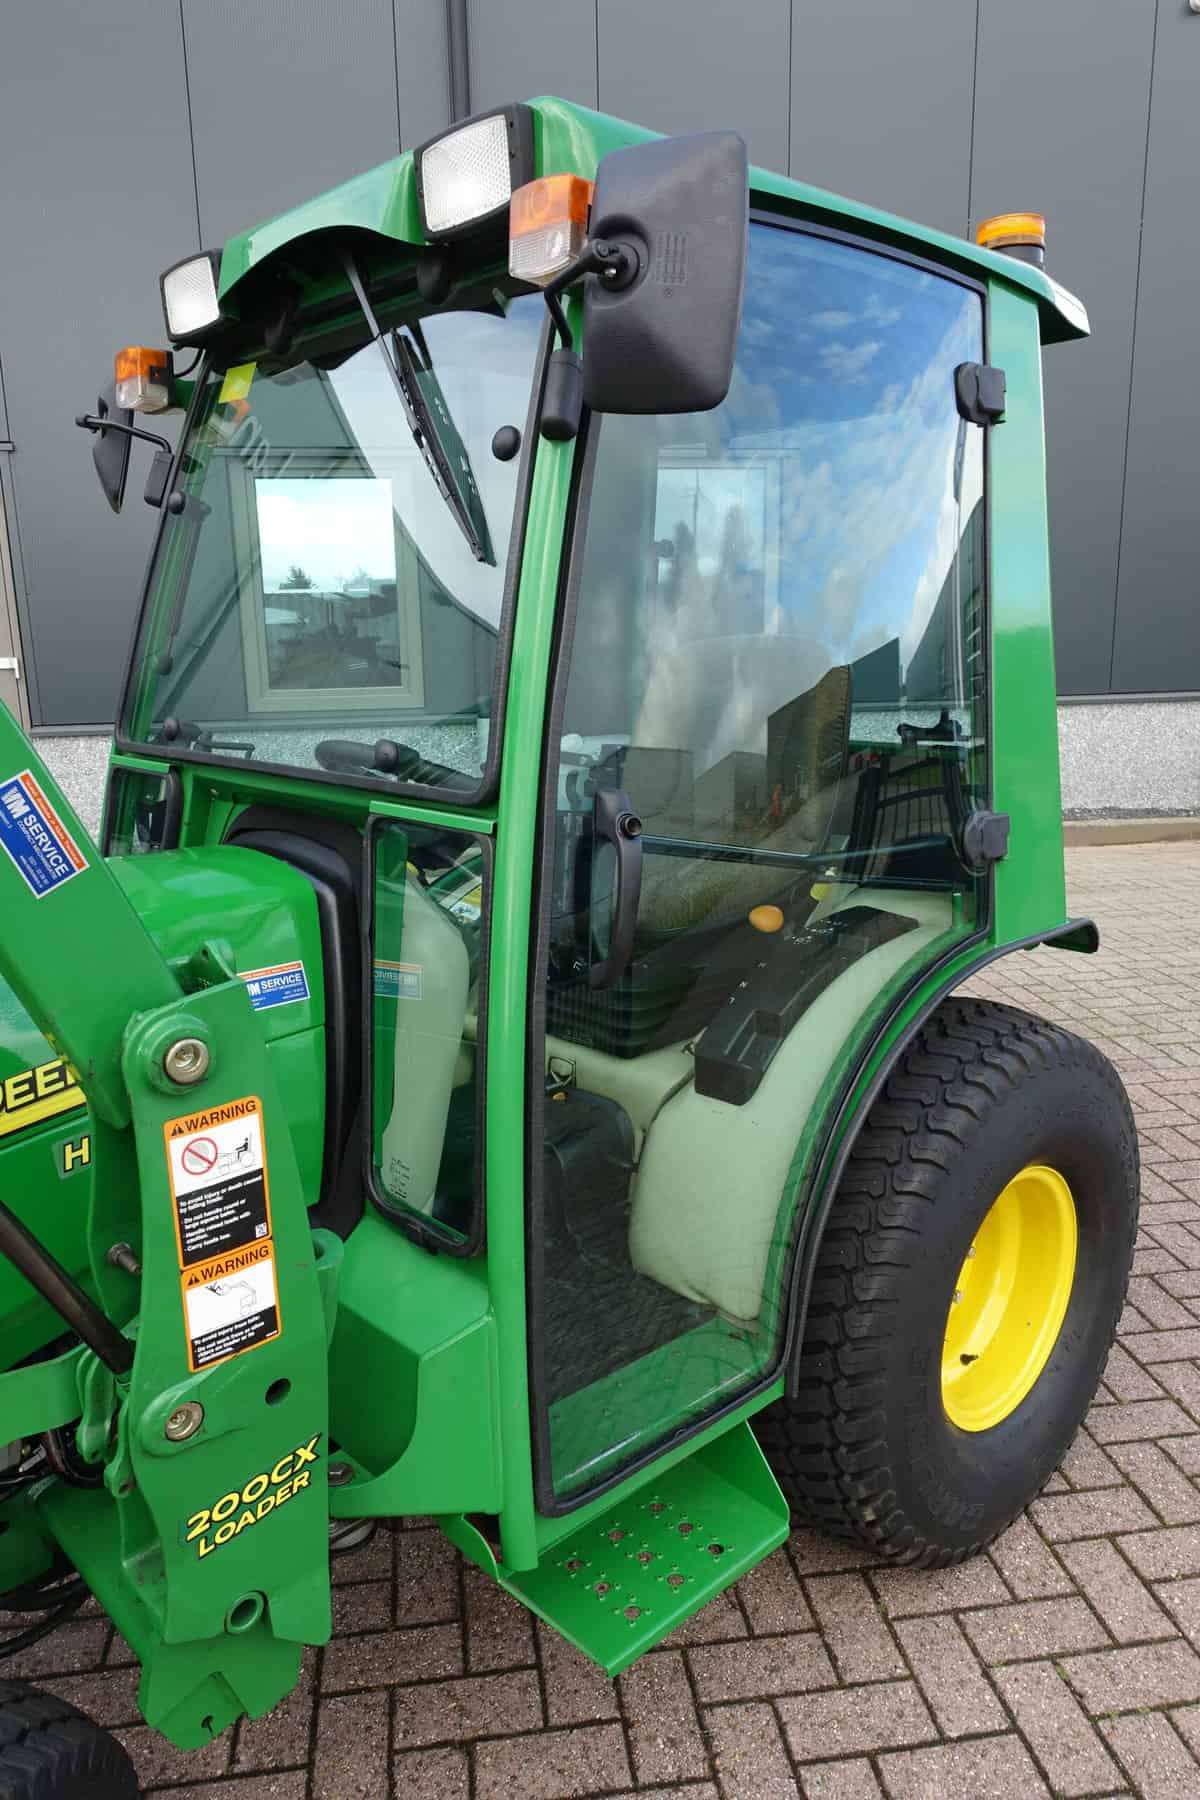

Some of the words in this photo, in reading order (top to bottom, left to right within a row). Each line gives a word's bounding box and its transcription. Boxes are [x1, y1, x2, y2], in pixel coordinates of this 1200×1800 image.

[23, 814, 70, 877] SERVICE
[261, 973, 302, 990] SERVICE
[0, 1058, 77, 1112] EE
[184, 1099, 257, 1132] WARNING
[63, 1135, 91, 1173] H
[200, 1245, 269, 1281] WARNING
[186, 1433, 321, 1541] 200CX
[198, 1470, 311, 1560] LOADER
